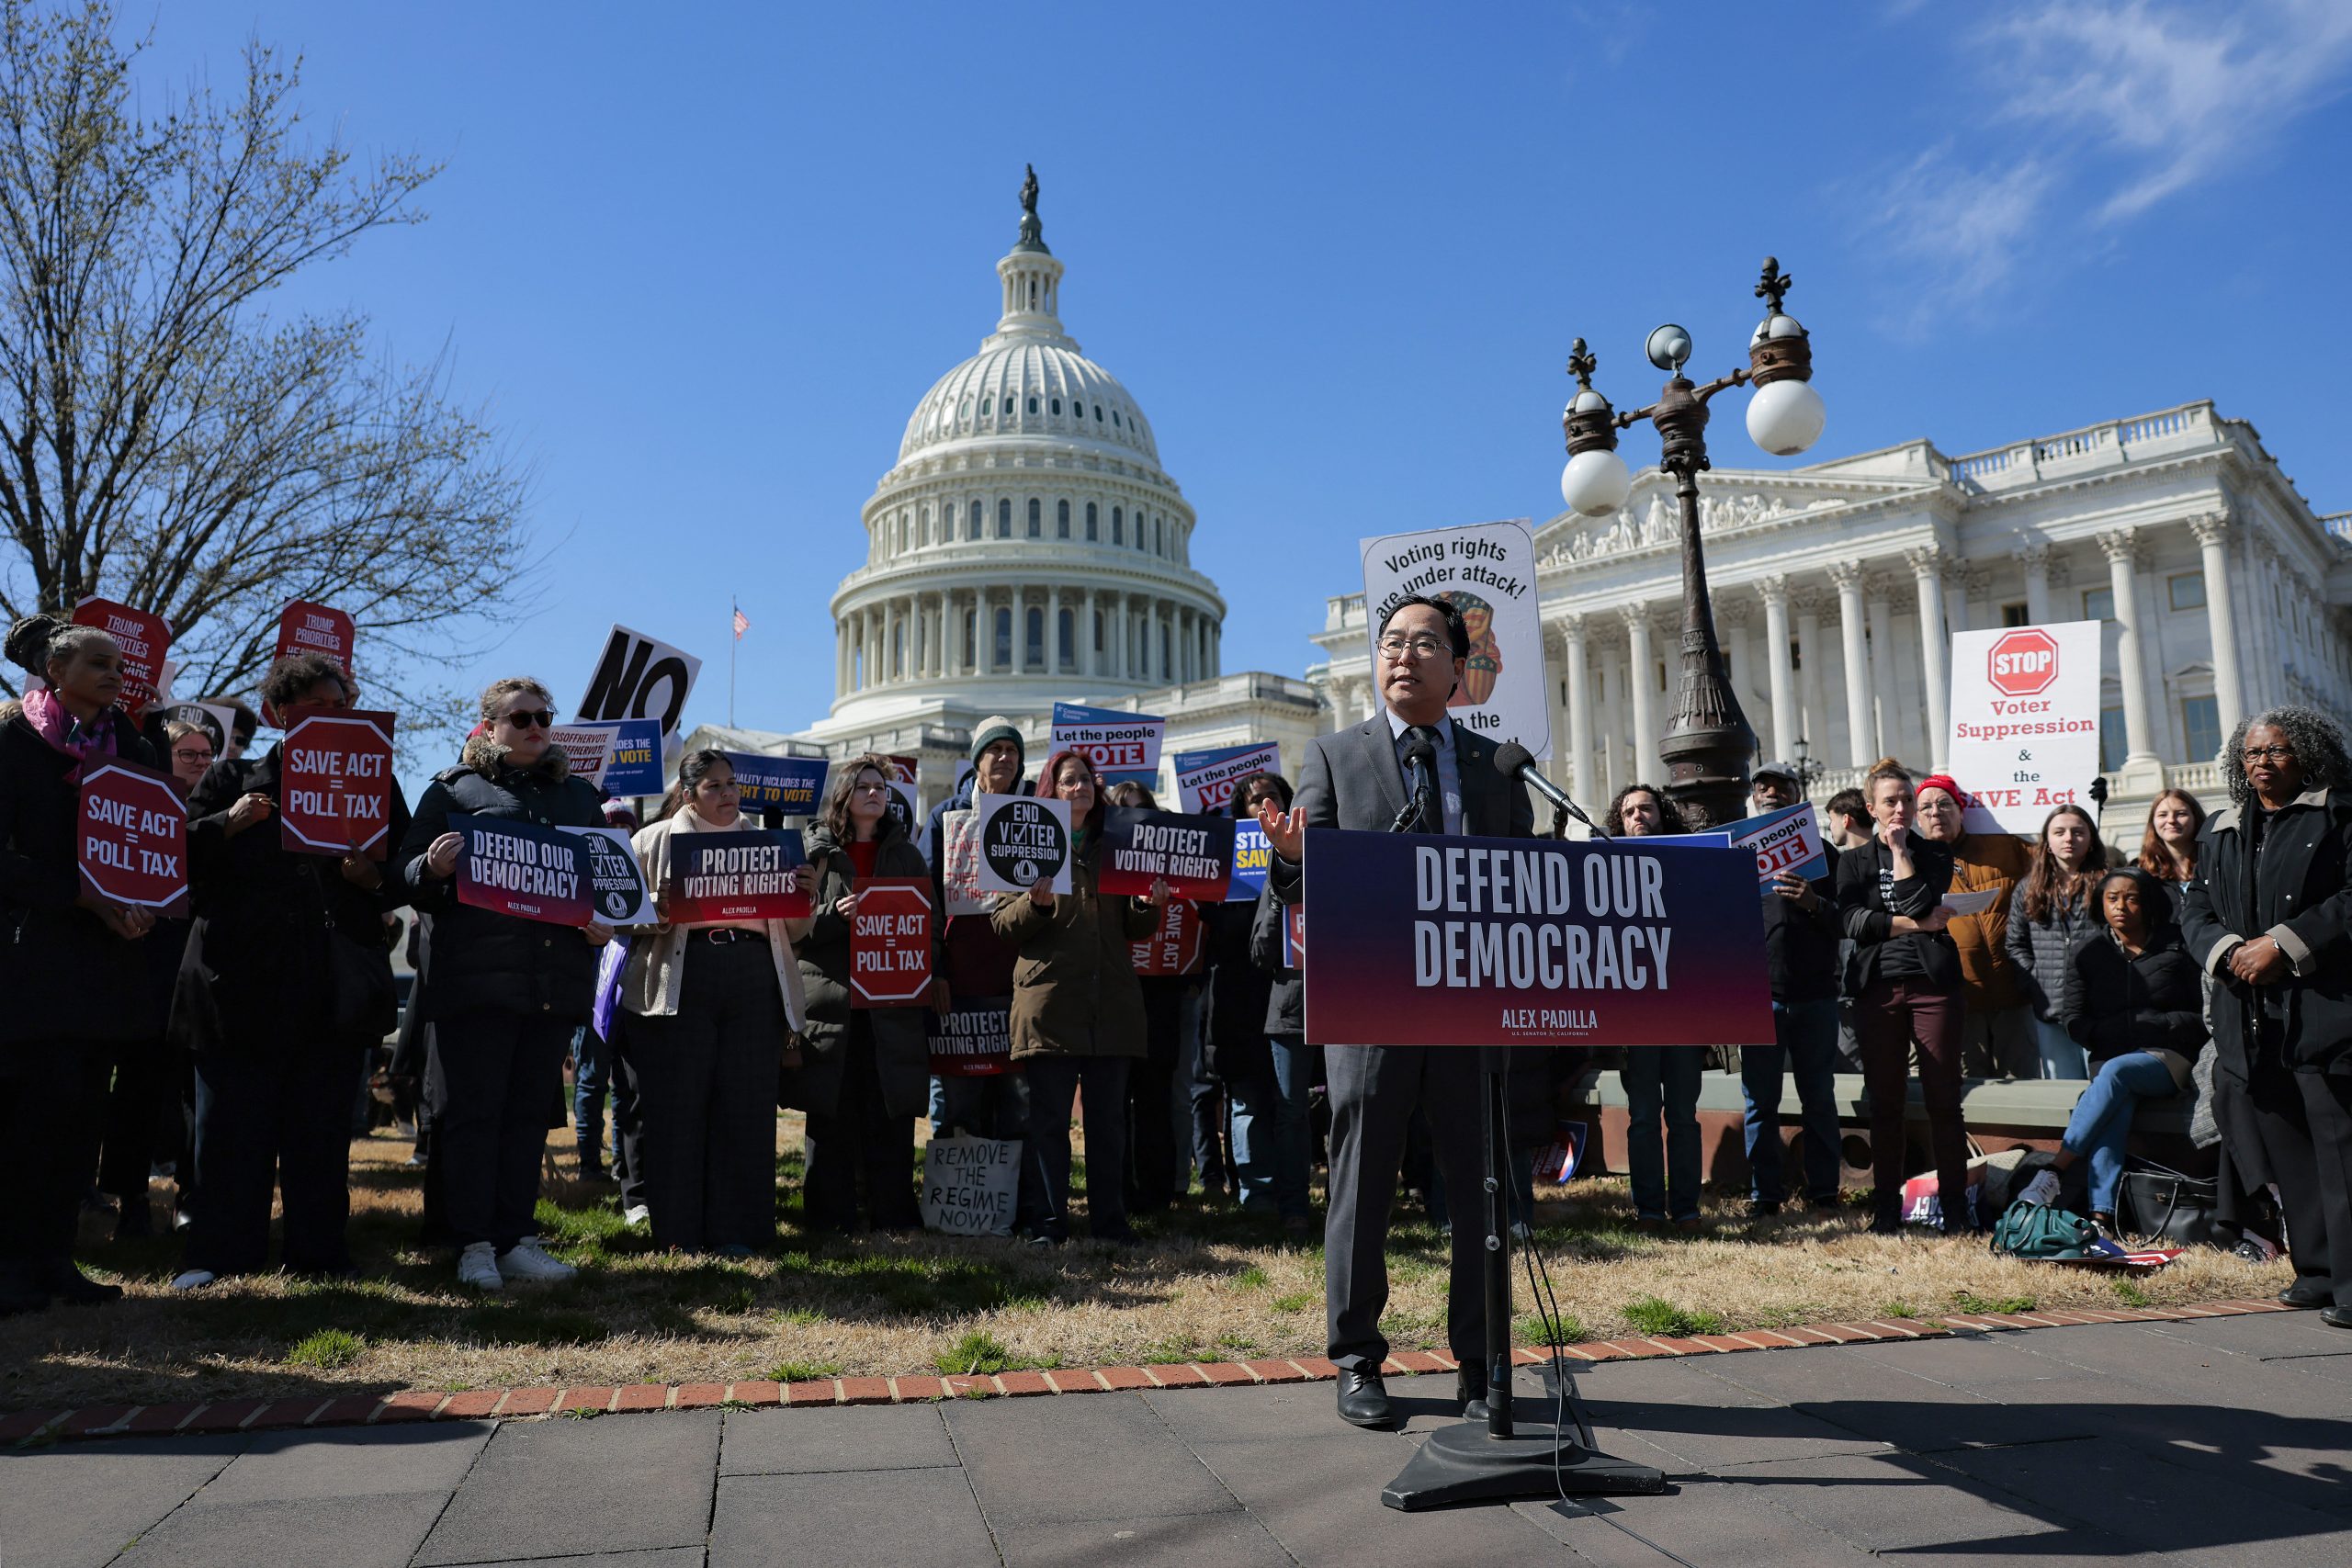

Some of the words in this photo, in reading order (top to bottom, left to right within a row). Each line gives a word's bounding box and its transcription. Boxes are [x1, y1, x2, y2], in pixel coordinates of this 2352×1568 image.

[1385, 543, 1444, 574] Voting
[1452, 536, 1507, 562] rights
[1375, 592, 1399, 619] are
[1402, 566, 1456, 593] under
[1462, 565, 1527, 600] attack!
[107, 615, 144, 637] TRUMP
[304, 613, 334, 632] TRUMP
[295, 627, 341, 649] PRIORITIES
[1996, 650, 2052, 675] STOP
[579, 629, 688, 738] NO
[178, 706, 204, 724] END
[1991, 699, 2051, 716] Voter
[1470, 711, 1500, 729] the
[1957, 717, 2095, 740] Suppression
[635, 738, 651, 749] THE
[1056, 729, 1077, 741] Let
[1080, 728, 1102, 740] the
[1105, 727, 1155, 742] people
[289, 748, 343, 776] SAVE
[345, 752, 386, 778] ACT
[619, 749, 651, 763] VOTE
[2018, 749, 2032, 761] &
[1182, 774, 1204, 788] Let
[1204, 768, 1227, 785] the
[1227, 753, 1272, 776] people
[2014, 771, 2041, 783] the
[330, 779, 344, 789] =
[763, 775, 800, 788] INCLUDES
[801, 778, 817, 789] THE
[1200, 780, 1236, 806] VO
[289, 789, 339, 818] POLL
[344, 794, 382, 819] TAX
[763, 786, 781, 801] TO
[784, 788, 814, 803] VOTE
[2033, 788, 2075, 806] Act
[87, 794, 137, 830] SAVE
[140, 809, 179, 839] ACT
[1013, 804, 1039, 823] END
[125, 832, 139, 844] =
[1131, 823, 1208, 856] PROTECT
[1236, 831, 1272, 851] STO
[1759, 818, 1809, 849] people
[86, 836, 135, 872] POLL
[139, 849, 178, 879] TAX
[472, 829, 537, 865] DEFEND
[540, 842, 575, 873] OUR
[701, 845, 781, 874] PROTECT
[990, 844, 1059, 862] SUPPRESSION
[1236, 849, 1272, 869] SAV
[1757, 839, 1806, 874] OTE
[1114, 849, 1166, 874] VOTING
[1169, 853, 1220, 880] RIGHTS
[469, 855, 579, 900] DEMOCRACY
[592, 877, 639, 891] PPRESSION
[684, 874, 740, 898] VOTING
[742, 872, 797, 896] RIGHTS
[1416, 846, 1571, 915] DEFEND
[1583, 852, 1667, 919] OUR
[946, 887, 959, 903] TO
[855, 915, 894, 936] SAVE
[896, 914, 926, 935] ACT
[1165, 903, 1183, 940] SAVE
[886, 939, 896, 947] =
[856, 950, 895, 972] POLL
[896, 950, 925, 971] TAX
[1131, 942, 1152, 970] TAX
[1162, 942, 1181, 970] ACT
[1414, 920, 1672, 991] DEMOCRACY
[939, 1010, 1007, 1035] PROTECT
[1501, 1009, 1537, 1029] ALEX
[1541, 1010, 1599, 1029] PADILLA
[928, 1036, 975, 1055] VOTING
[977, 1033, 1011, 1055] RIGH
[934, 1144, 1009, 1166] REMOVE
[955, 1166, 987, 1187] THE
[930, 1187, 1010, 1213] REGIME
[939, 1209, 997, 1231] NOW!
